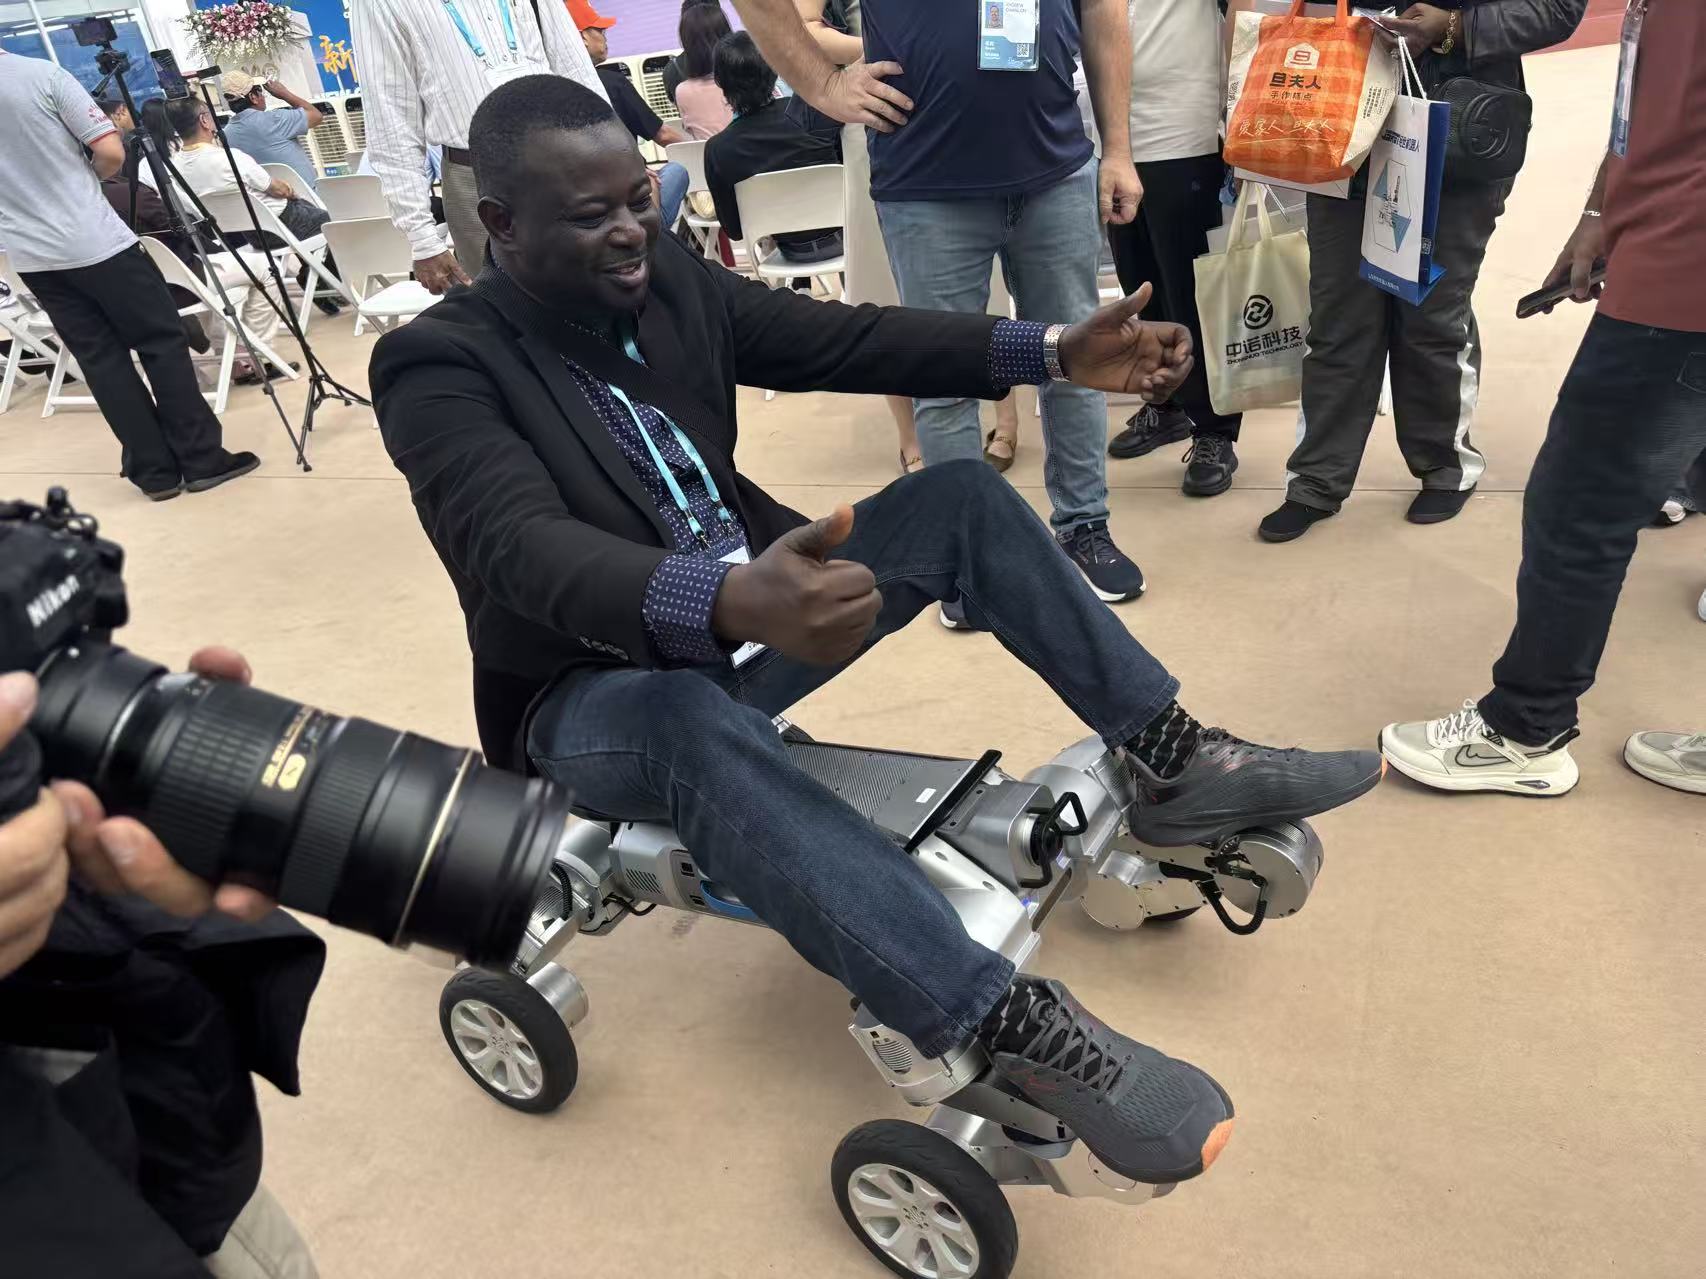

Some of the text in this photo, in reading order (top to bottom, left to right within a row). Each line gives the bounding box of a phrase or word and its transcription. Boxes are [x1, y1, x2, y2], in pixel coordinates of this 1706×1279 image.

[1269, 72, 1321, 89] 旦夫人
[1226, 326, 1302, 357] 中诺科技
[1261, 341, 1303, 356] TECHNOLOGY
[26, 575, 80, 627] Nikon
